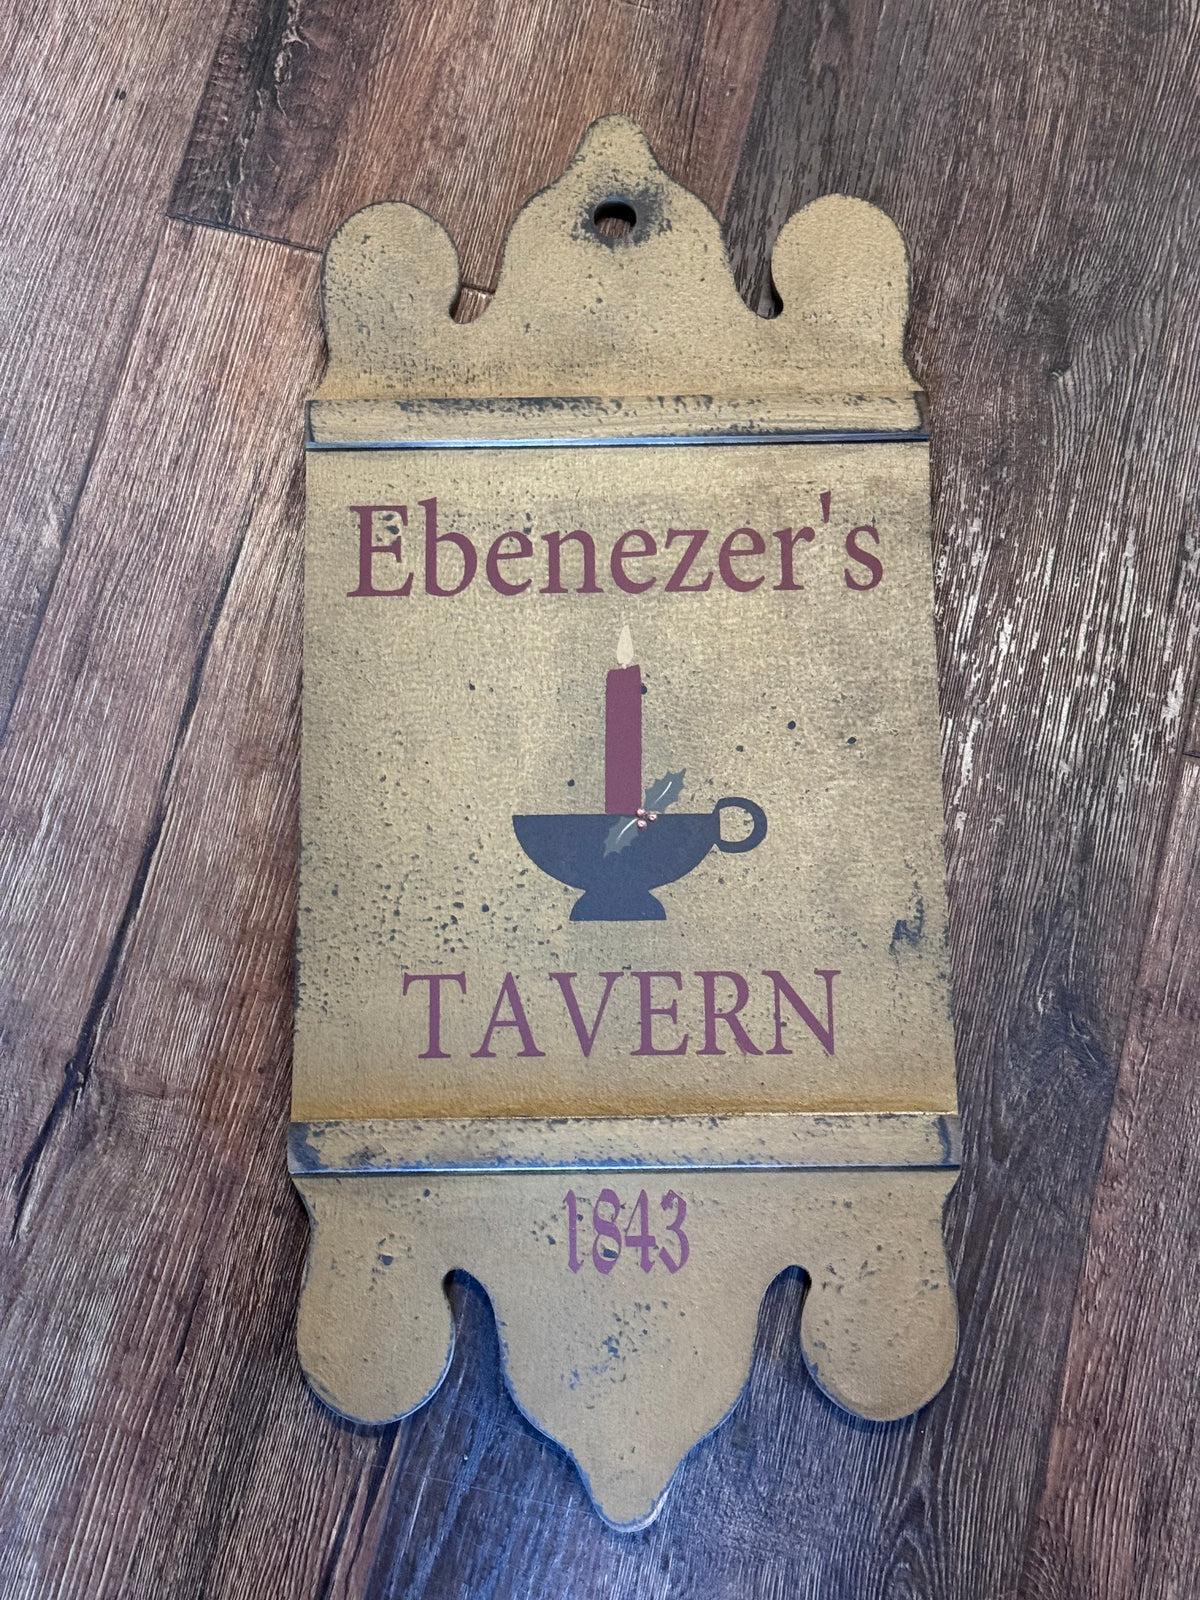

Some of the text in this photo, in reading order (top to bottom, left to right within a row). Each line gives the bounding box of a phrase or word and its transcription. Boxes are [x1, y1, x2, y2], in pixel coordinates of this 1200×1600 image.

[347, 492, 883, 597] Ebenezer's
[403, 968, 839, 1059] TAVERN
[563, 1188, 690, 1274] 1843
